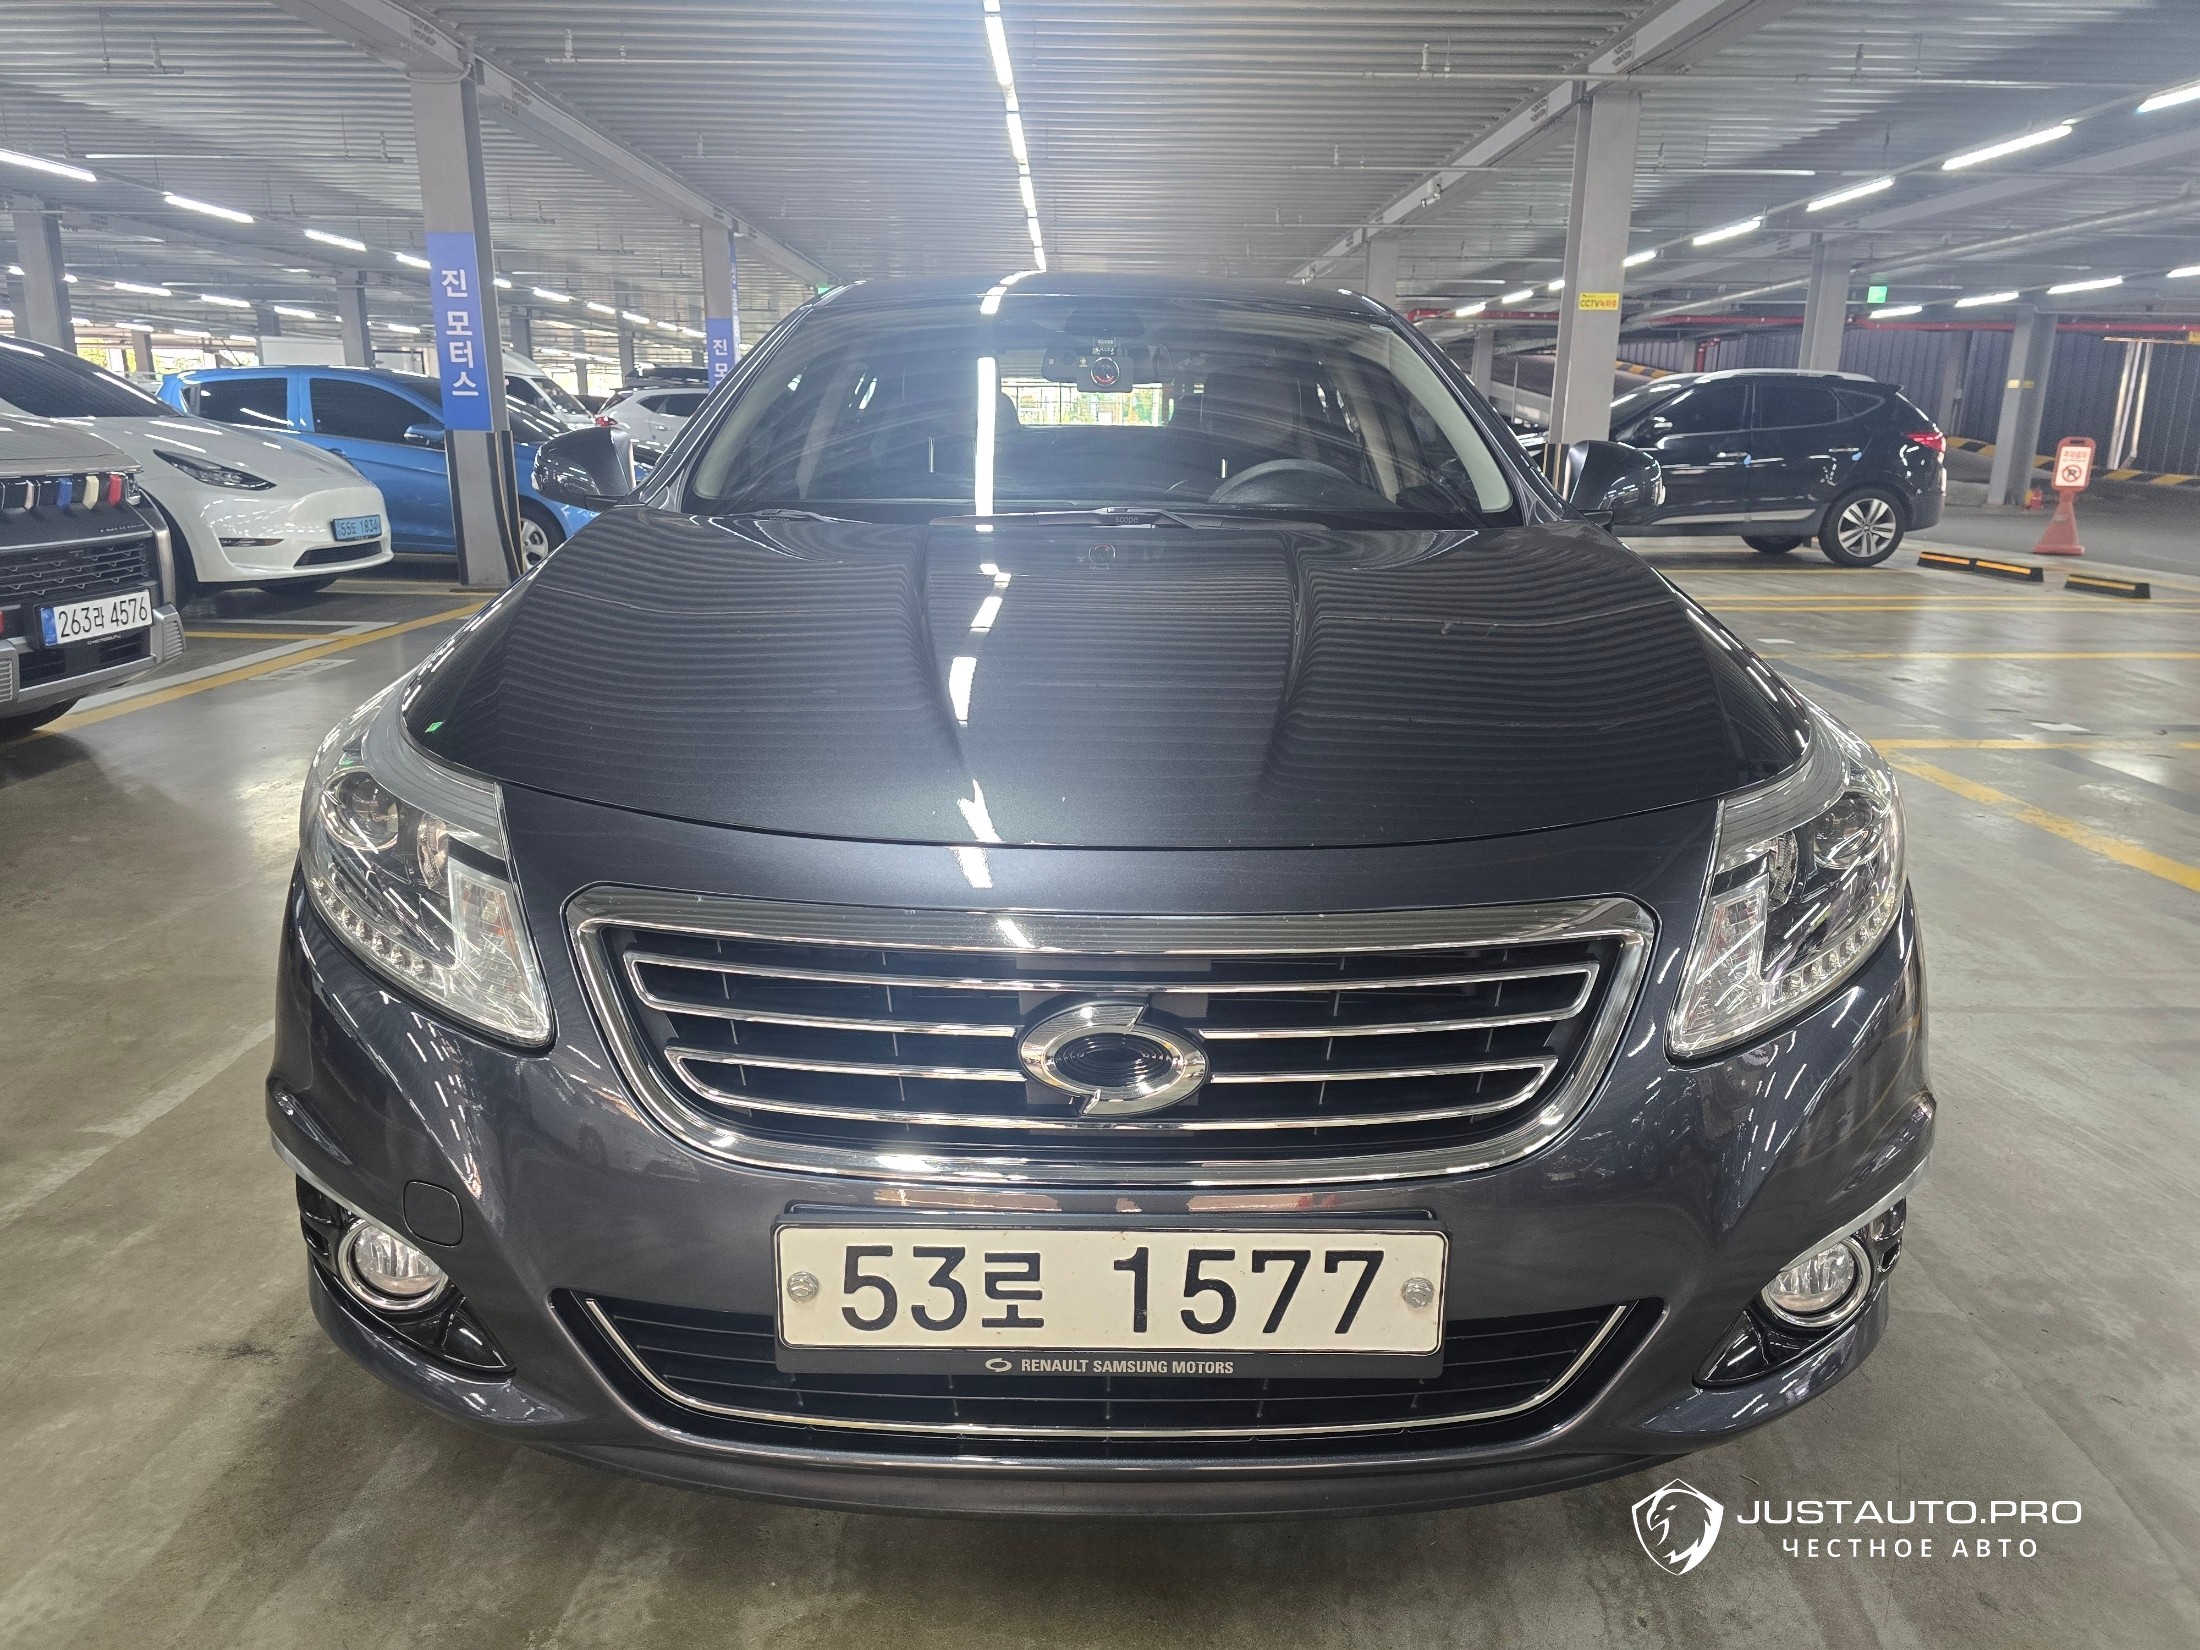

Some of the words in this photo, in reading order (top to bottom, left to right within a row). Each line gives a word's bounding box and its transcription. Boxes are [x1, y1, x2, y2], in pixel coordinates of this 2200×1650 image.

[441, 268, 468, 298] 진
[445, 310, 479, 397] 모터스
[712, 338, 729, 357] 진
[58, 605, 105, 638] 263라
[110, 596, 149, 627] 4576
[841, 1245, 1045, 1332] 53로
[1113, 1246, 1385, 1335] 1577
[1020, 1358, 1090, 1373] RENAULT
[1092, 1360, 1168, 1374] SAMSUNG
[1172, 1360, 1235, 1374] MOTORS
